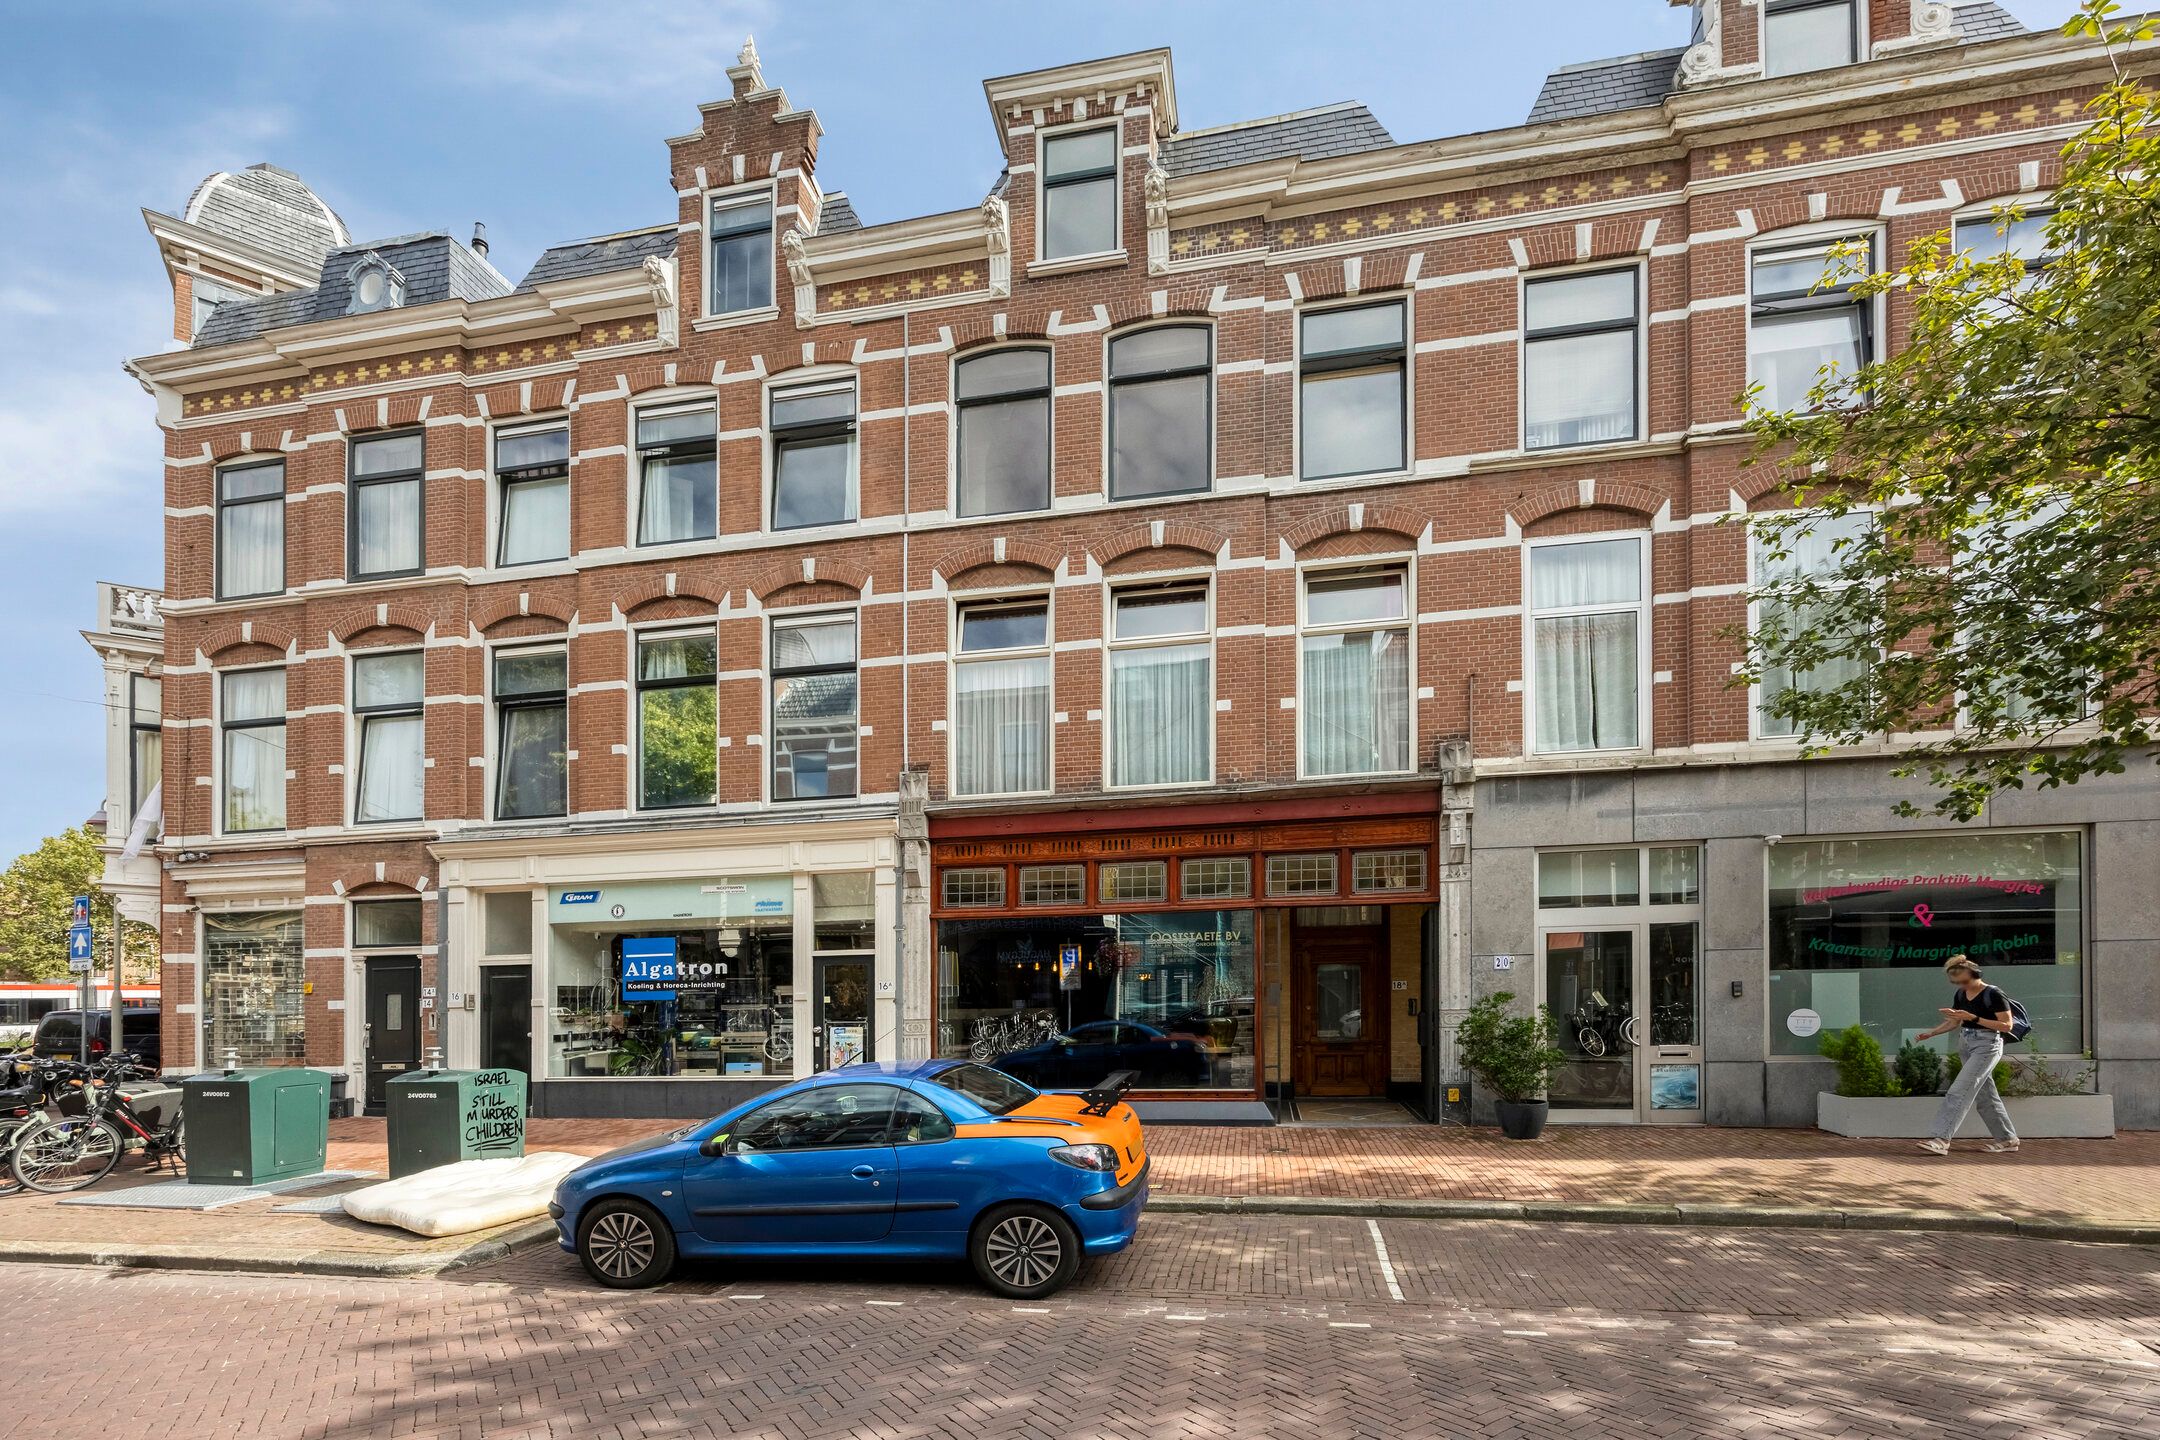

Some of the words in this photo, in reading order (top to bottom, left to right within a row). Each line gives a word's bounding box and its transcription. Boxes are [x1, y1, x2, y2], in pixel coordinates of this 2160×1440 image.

[1910, 903, 1935, 928] &
[1226, 931, 1241, 941] BV
[1808, 937, 1894, 960] Kraamzorg
[1897, 943, 1967, 961] Margriet
[1970, 943, 1990, 955] en
[1993, 933, 2040, 951] Robin
[625, 961, 728, 979] Algatron
[663, 981, 726, 989] Horeca-Inrichting
[474, 1071, 511, 1086] ISRAEL
[472, 1092, 506, 1108] STILL
[465, 1118, 523, 1141] CHILDREN
